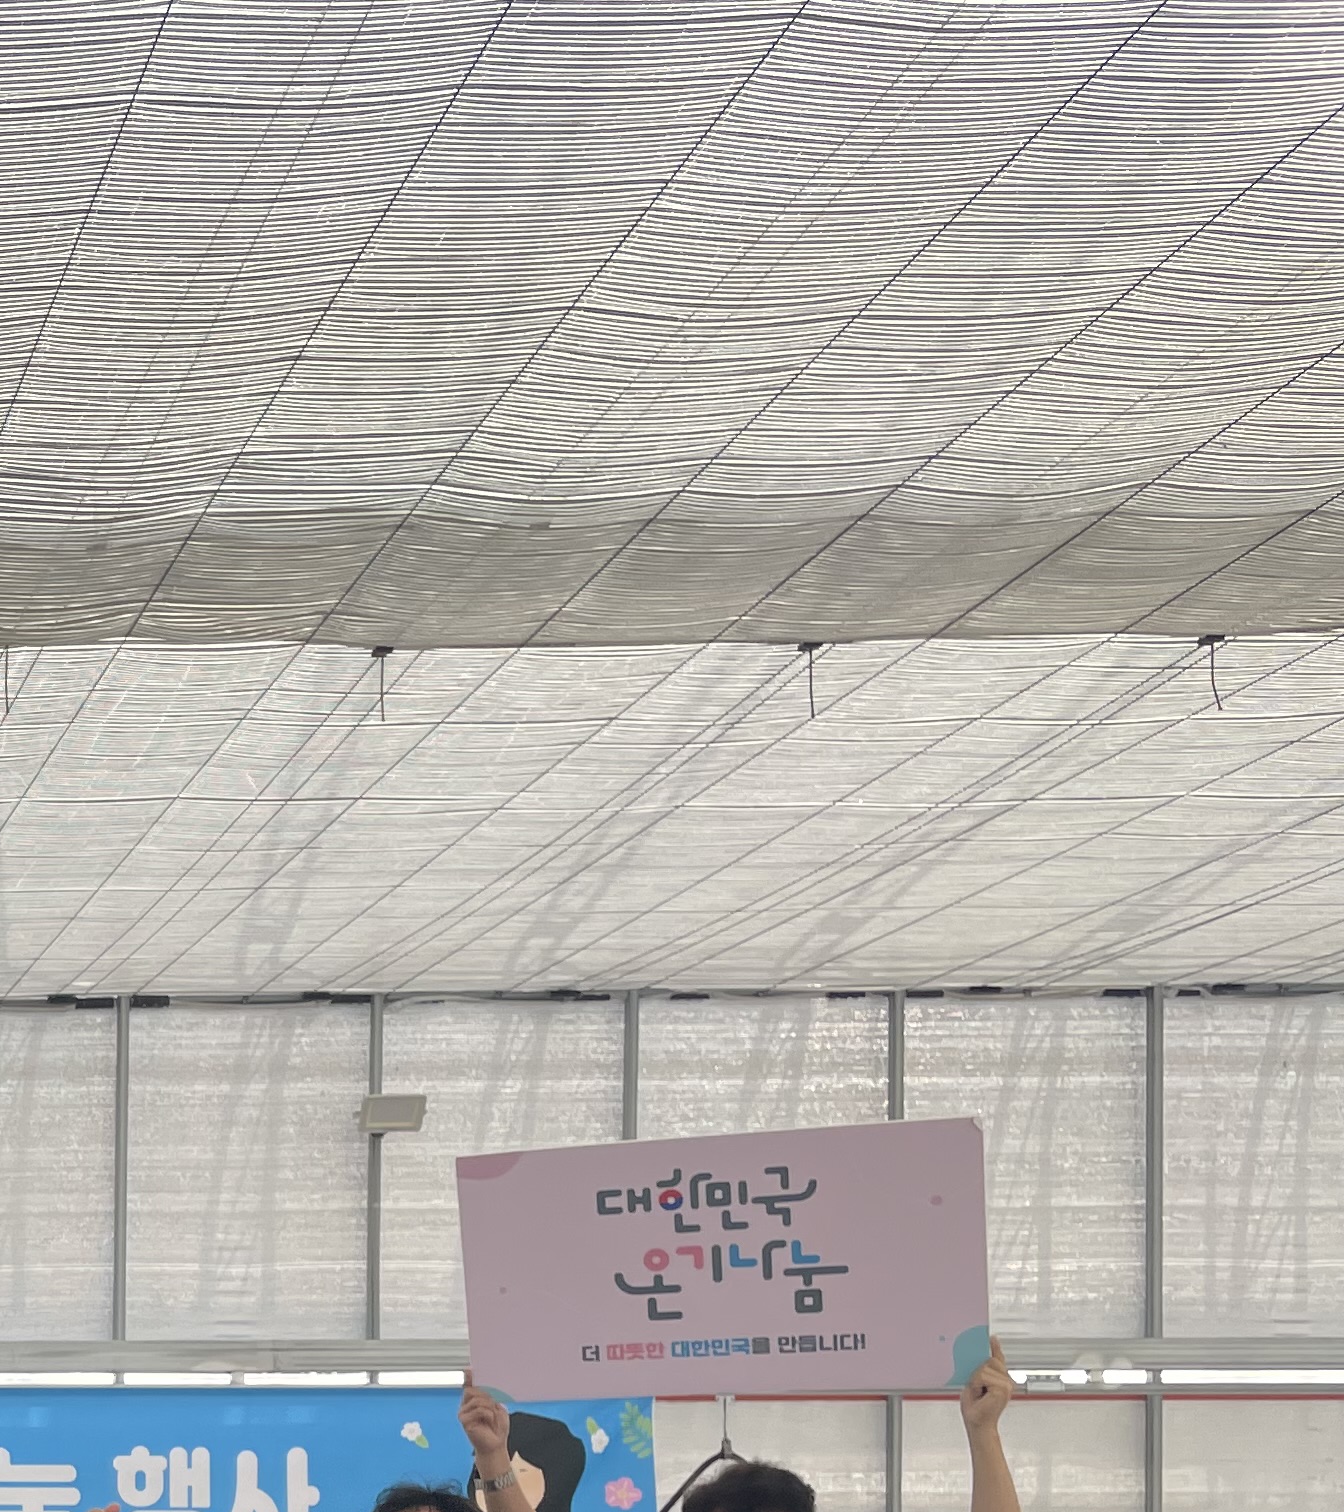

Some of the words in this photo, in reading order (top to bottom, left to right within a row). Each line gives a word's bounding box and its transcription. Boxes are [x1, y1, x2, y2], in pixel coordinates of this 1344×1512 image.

[596, 1166, 818, 1234] 대한민국
[614, 1239, 850, 1321] 온기나눔
[581, 1345, 601, 1362] 더
[606, 1342, 665, 1361] 따뜻한
